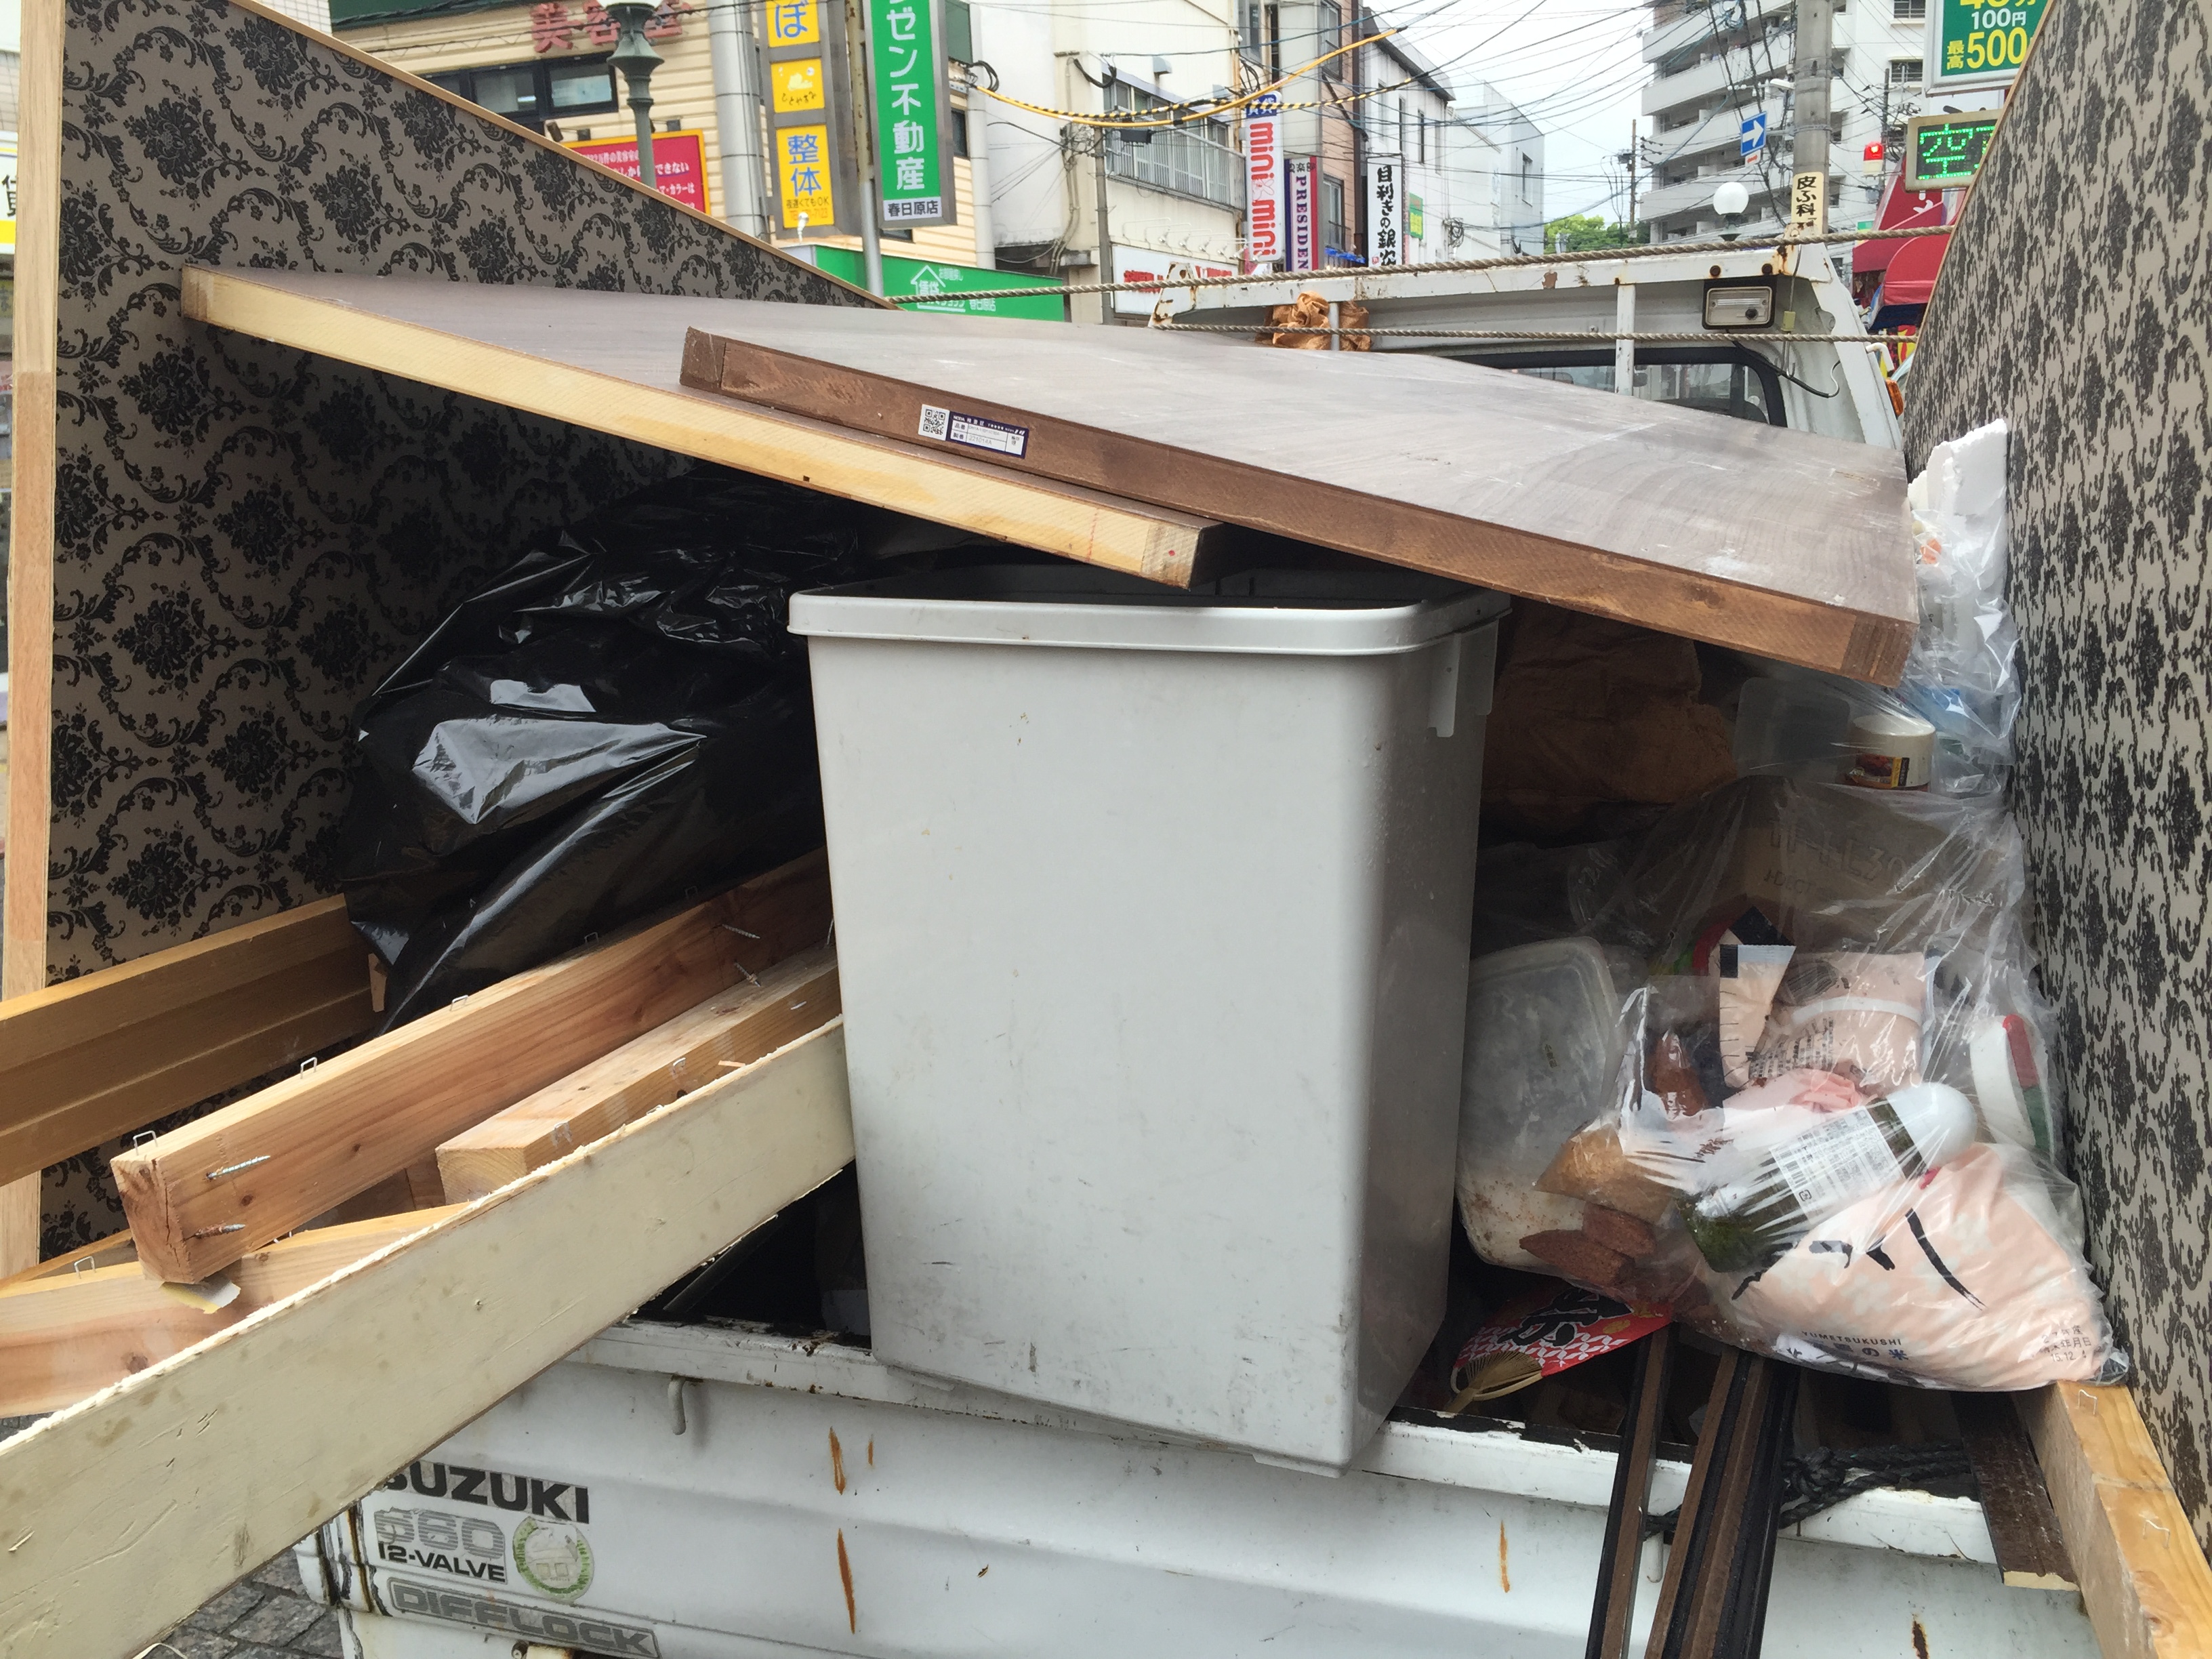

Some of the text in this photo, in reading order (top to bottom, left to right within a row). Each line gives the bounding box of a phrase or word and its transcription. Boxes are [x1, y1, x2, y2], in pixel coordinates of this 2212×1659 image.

[1971, 8, 2027, 29] 100円
[1947, 27, 2032, 70] 最高 500
[886, 0, 925, 190] ゼン不動産
[787, 134, 822, 197] 整体
[888, 200, 938, 218] 春日原店
[1250, 122, 1276, 256] mini mini
[1796, 176, 1817, 217] 皮ふ科
[1296, 175, 1309, 270] PRESIDEN
[1801, 1330, 1902, 1346] YUMETSUKUSHI
[377, 1542, 507, 1583] 12-VALVE
